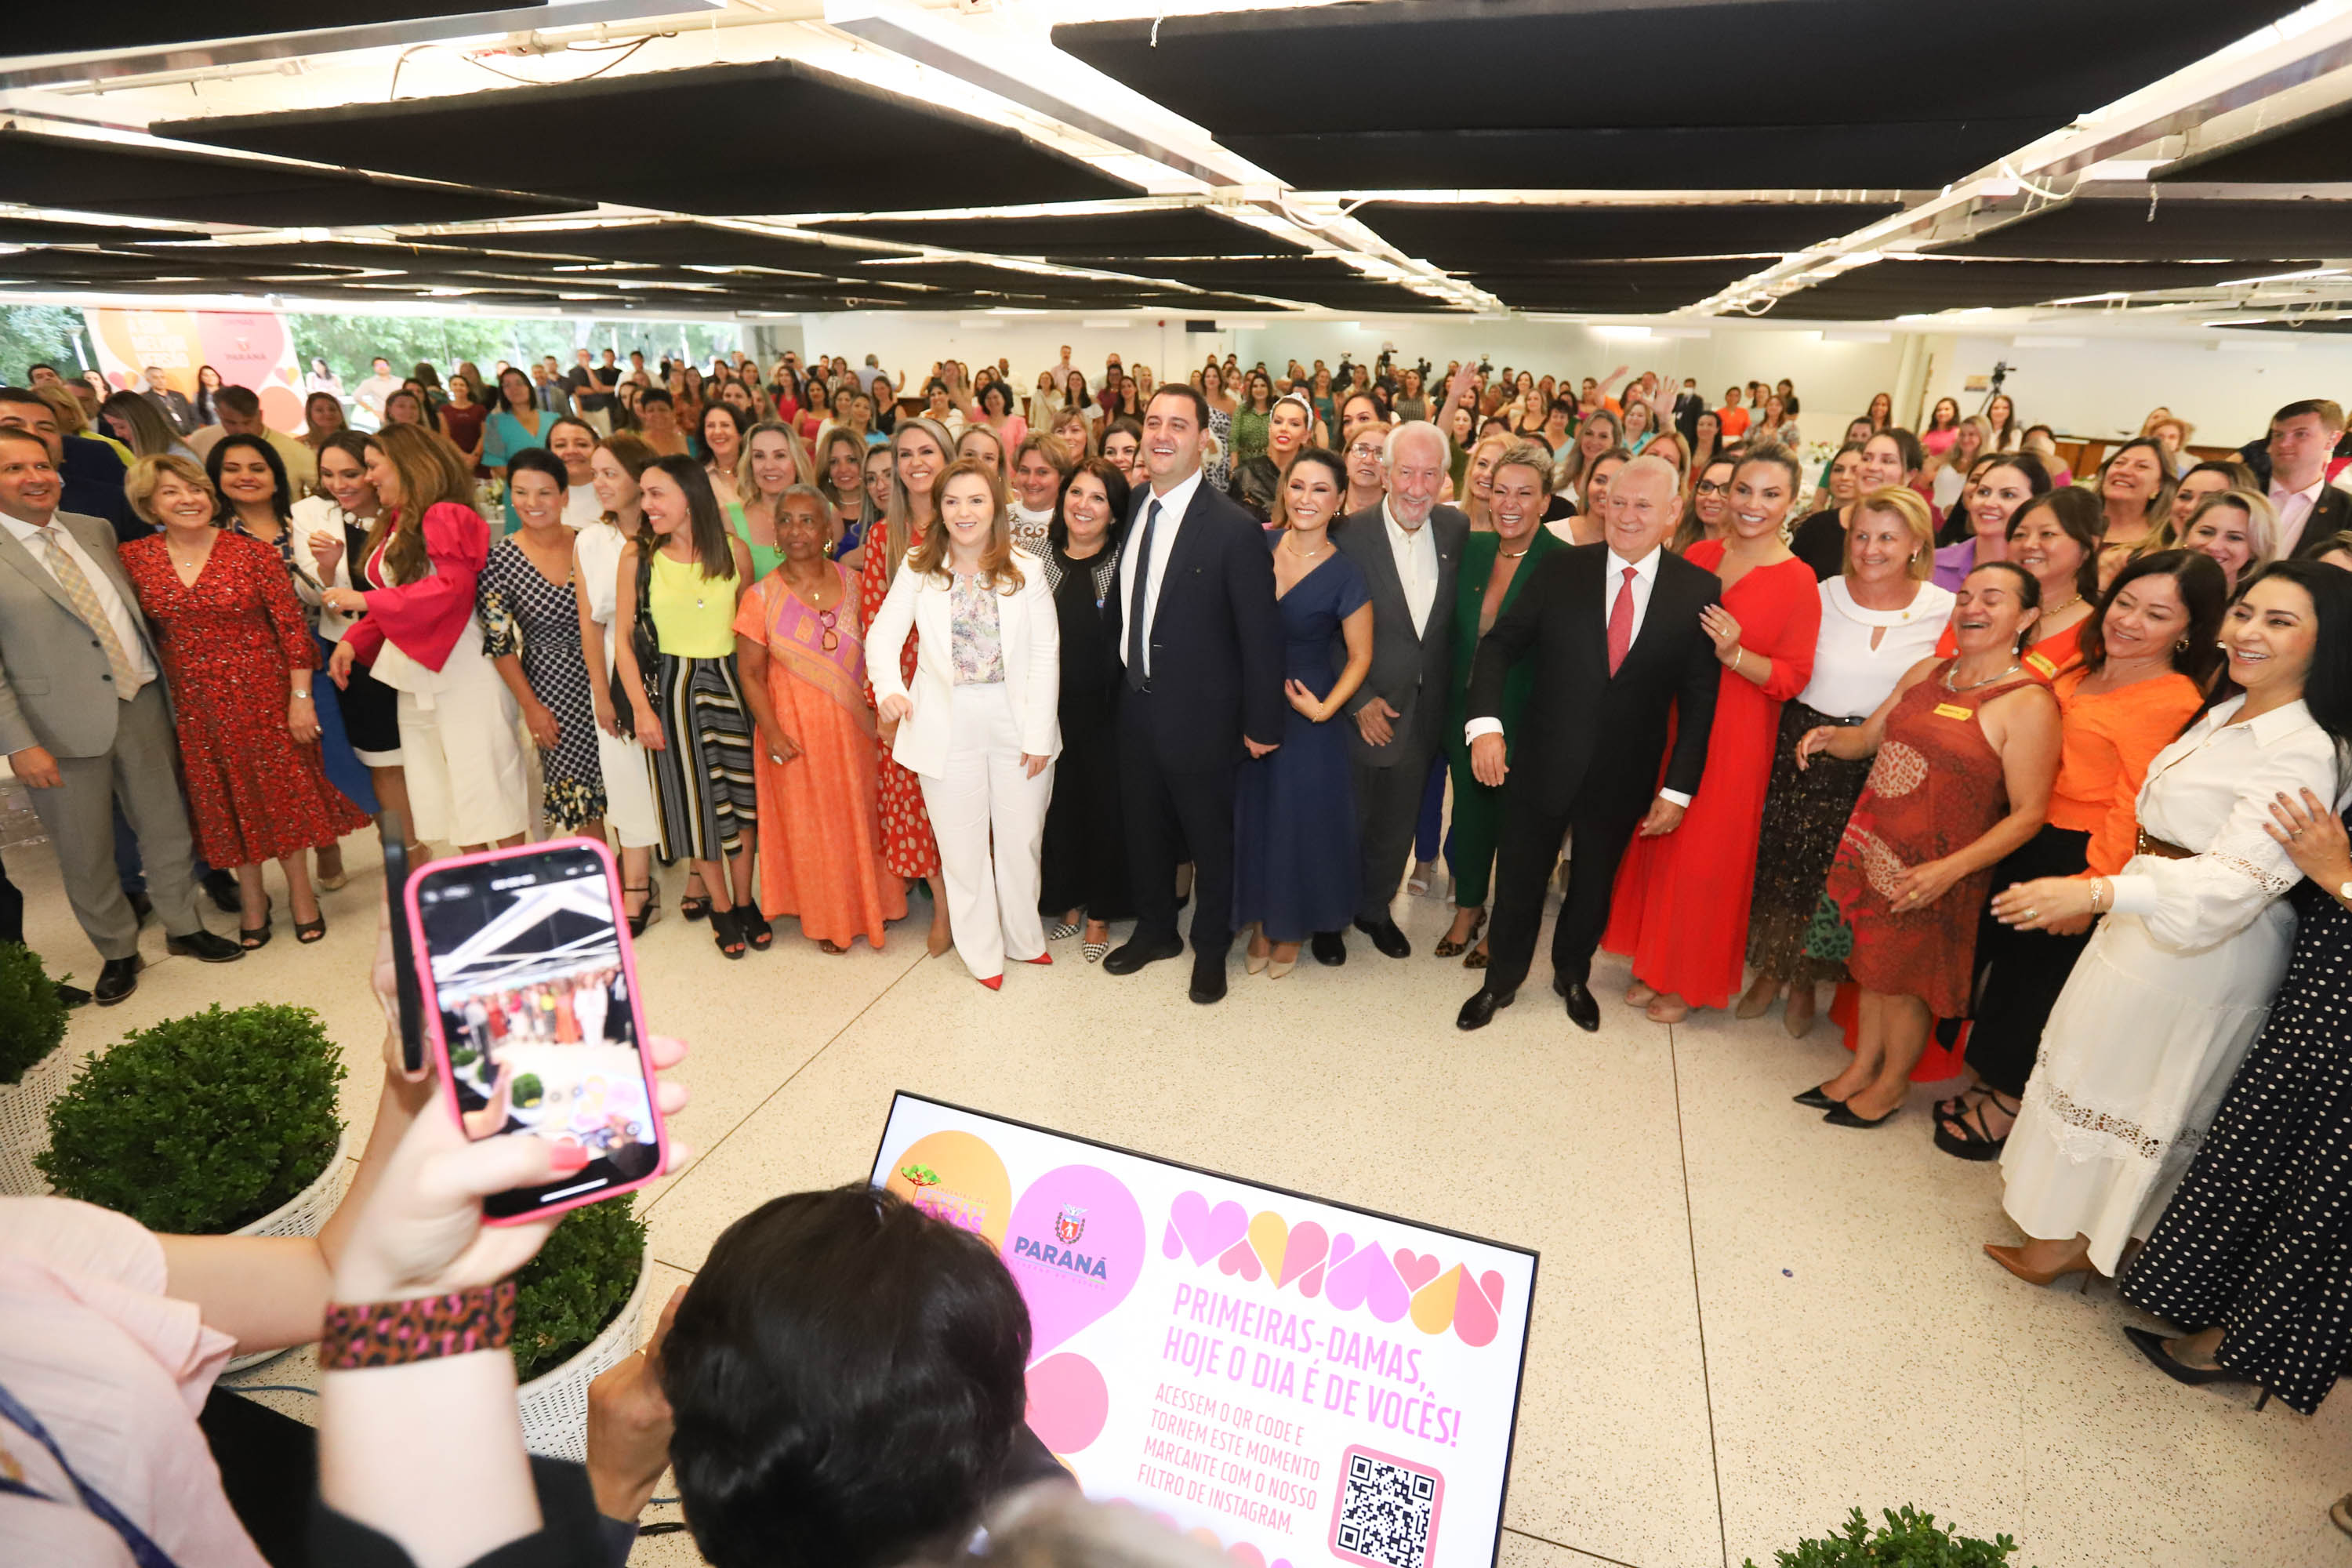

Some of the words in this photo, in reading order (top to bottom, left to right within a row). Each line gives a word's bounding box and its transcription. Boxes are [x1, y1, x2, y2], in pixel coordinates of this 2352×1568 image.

[1014, 1236, 1107, 1279] PARANÁ
[1172, 1283, 1426, 1392] PRIMEIRAS-DAMAS,
[1155, 1383, 1217, 1418] ACESSEM
[1220, 1403, 1230, 1422] O
[1232, 1406, 1253, 1430] QR
[1255, 1414, 1293, 1443] CODE
[1295, 1426, 1305, 1446] E
[1163, 1326, 1224, 1377] HOJE
[1227, 1345, 1247, 1381] O
[1251, 1352, 1295, 1398] DIA
[1301, 1358, 1319, 1404] É
[1323, 1373, 1361, 1417] DE
[1367, 1385, 1461, 1447] VOCÊS!
[1144, 1436, 1218, 1477] MARCANTE
[1221, 1461, 1252, 1489] COM
[1254, 1472, 1265, 1493] O
[1268, 1476, 1317, 1510] NOSSO
[1151, 1408, 1208, 1444] TORNEM
[1210, 1428, 1244, 1456] ESTE
[1246, 1440, 1320, 1481] MOMENTO
[1138, 1464, 1185, 1496] FILTRO
[1186, 1479, 1207, 1504] DE
[1208, 1487, 1293, 1535] INSTAGRAM.
